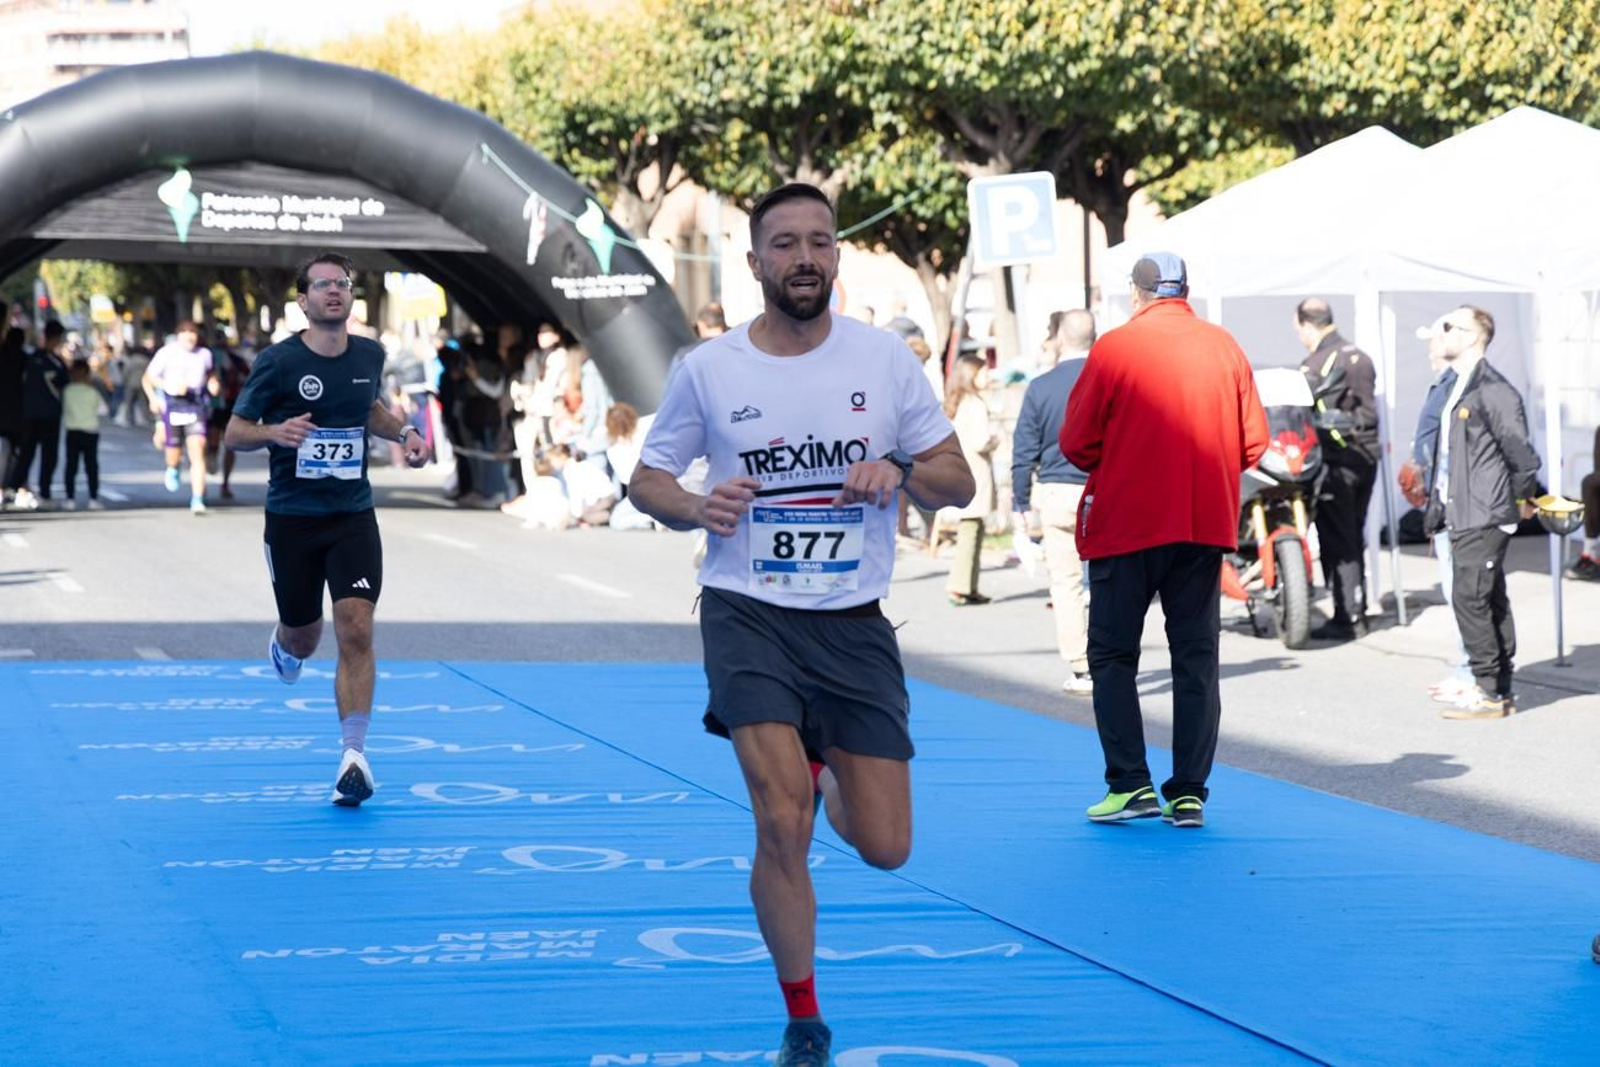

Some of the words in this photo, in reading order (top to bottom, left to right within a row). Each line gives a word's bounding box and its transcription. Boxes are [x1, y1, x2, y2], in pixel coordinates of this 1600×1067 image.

[282, 195, 360, 215] Municipal
[361, 199, 385, 216] de
[277, 213, 300, 230] de
[986, 186, 1039, 256] P
[312, 443, 353, 460] 373
[773, 531, 845, 560] 877
[358, 951, 593, 966] MEDIA
